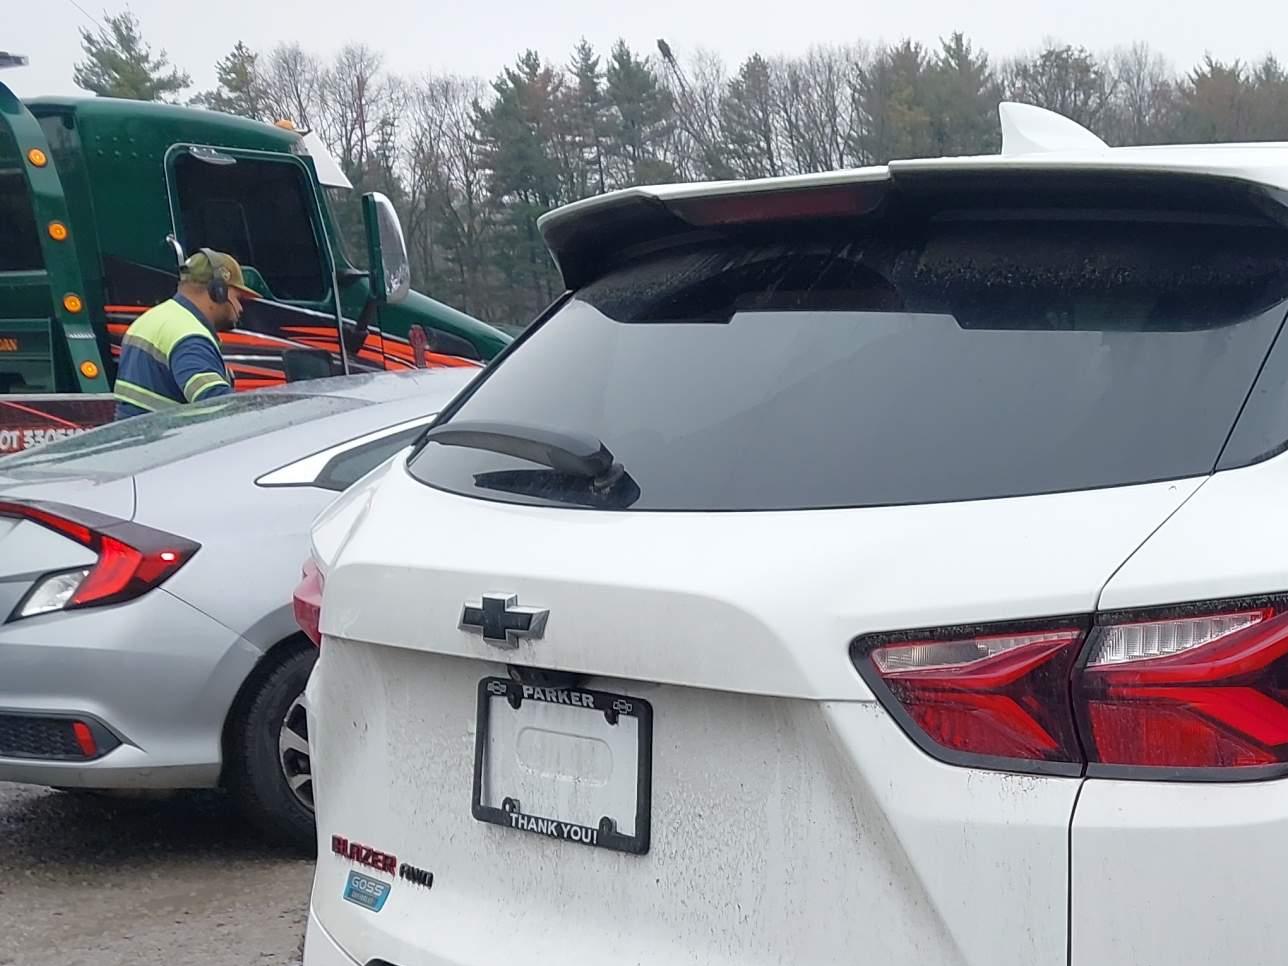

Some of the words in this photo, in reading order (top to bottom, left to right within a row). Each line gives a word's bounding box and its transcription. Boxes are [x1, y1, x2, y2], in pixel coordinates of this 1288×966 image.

[522, 684, 595, 708] PARKER
[509, 812, 558, 837] THANK
[560, 823, 598, 845] YOU!
[331, 833, 396, 876] BLAZER
[399, 862, 434, 890] AWD
[351, 876, 385, 897] GOSS
